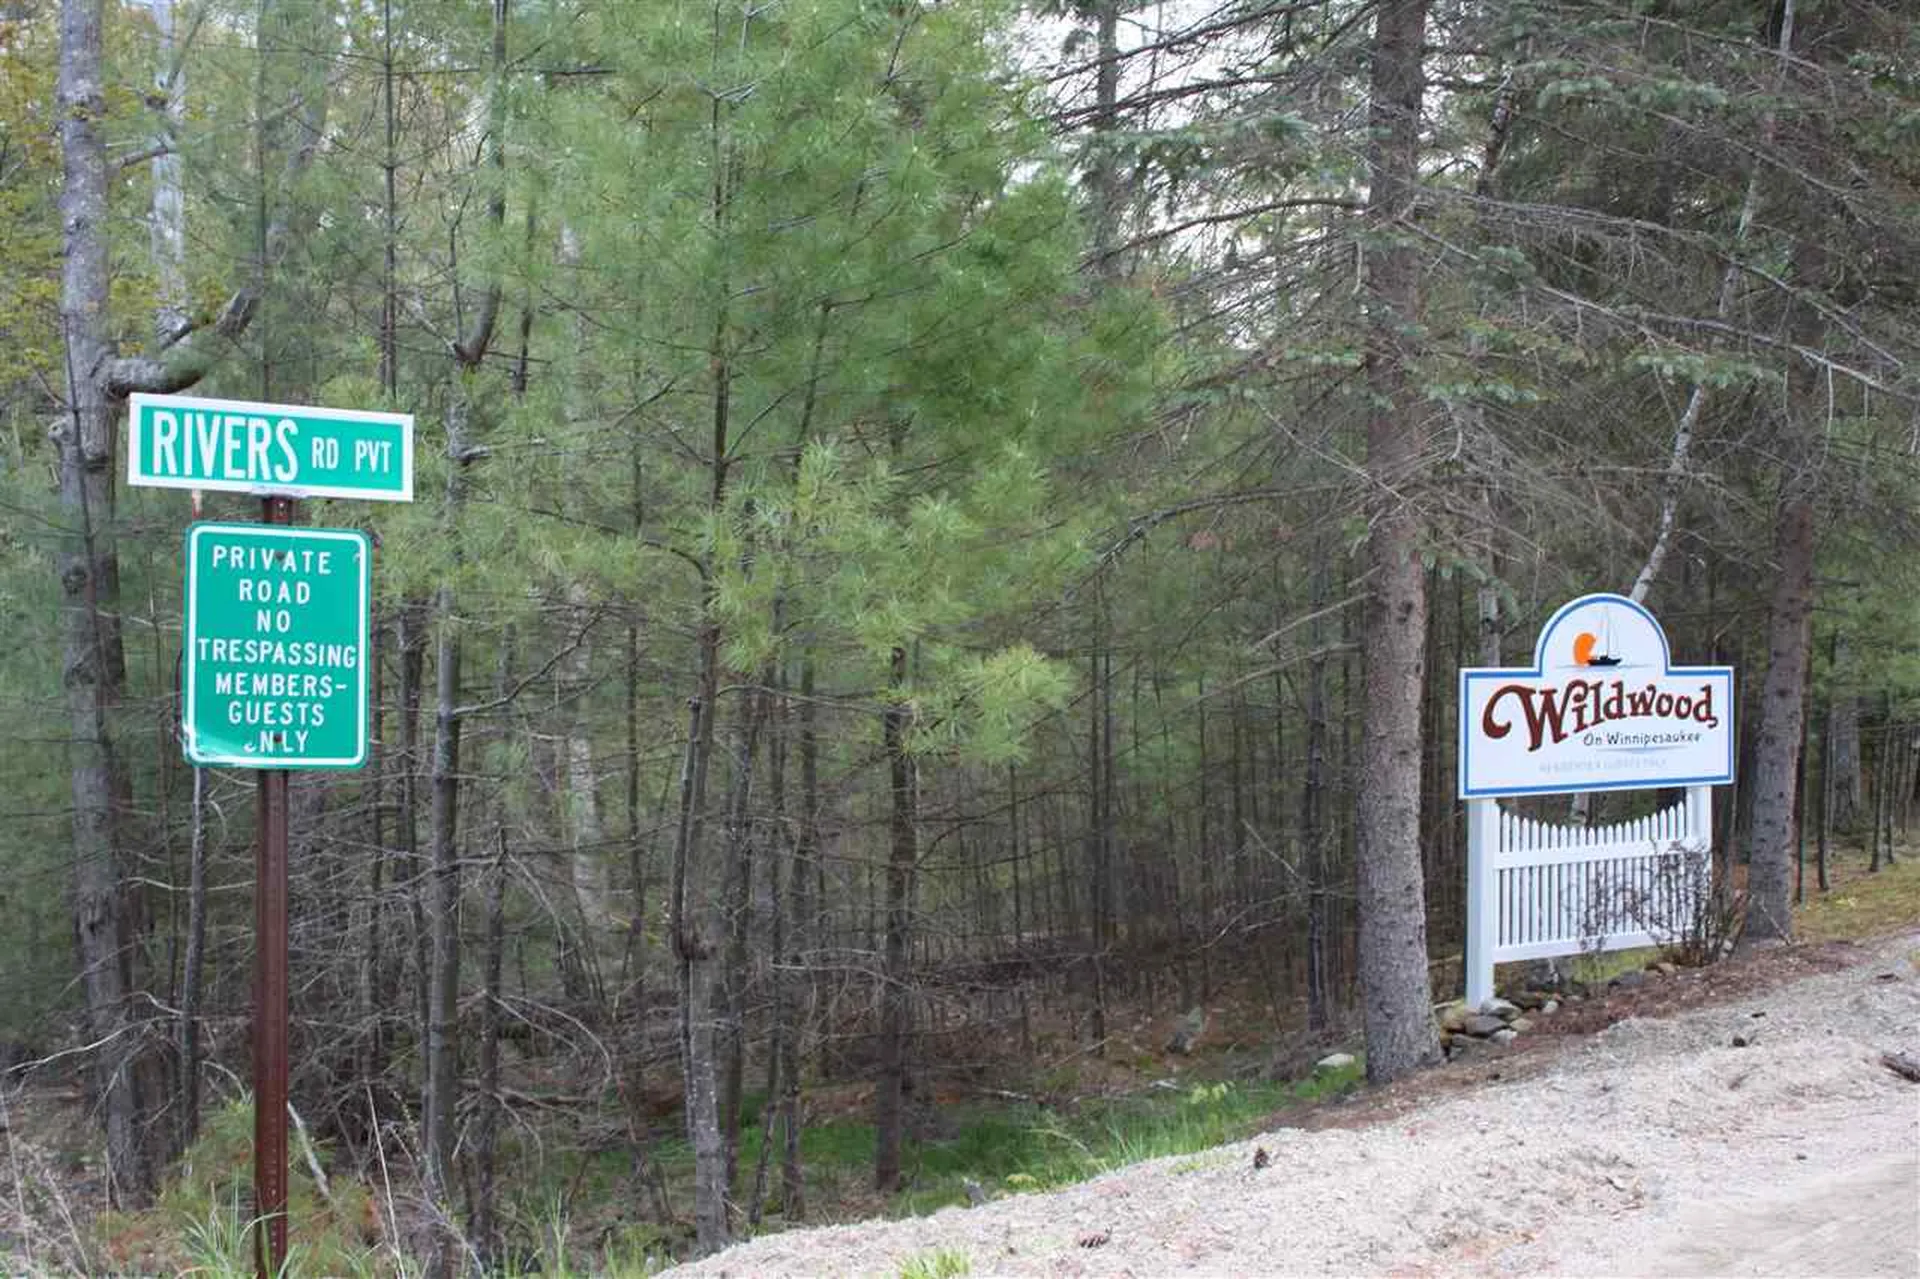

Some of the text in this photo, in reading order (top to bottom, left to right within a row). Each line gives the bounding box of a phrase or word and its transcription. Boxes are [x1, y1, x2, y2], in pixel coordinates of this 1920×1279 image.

[152, 410, 392, 482] RIVERS RD PVT
[212, 545, 332, 575] PRIVATE
[239, 579, 311, 604] ROAD
[256, 609, 291, 633] NO
[197, 638, 357, 668] TRESPASSING
[215, 672, 347, 698] MEMBERS-
[228, 701, 325, 727] GUESTS
[1482, 679, 1719, 752] Wildwood
[1583, 729, 1702, 749] On Winnipesaukee
